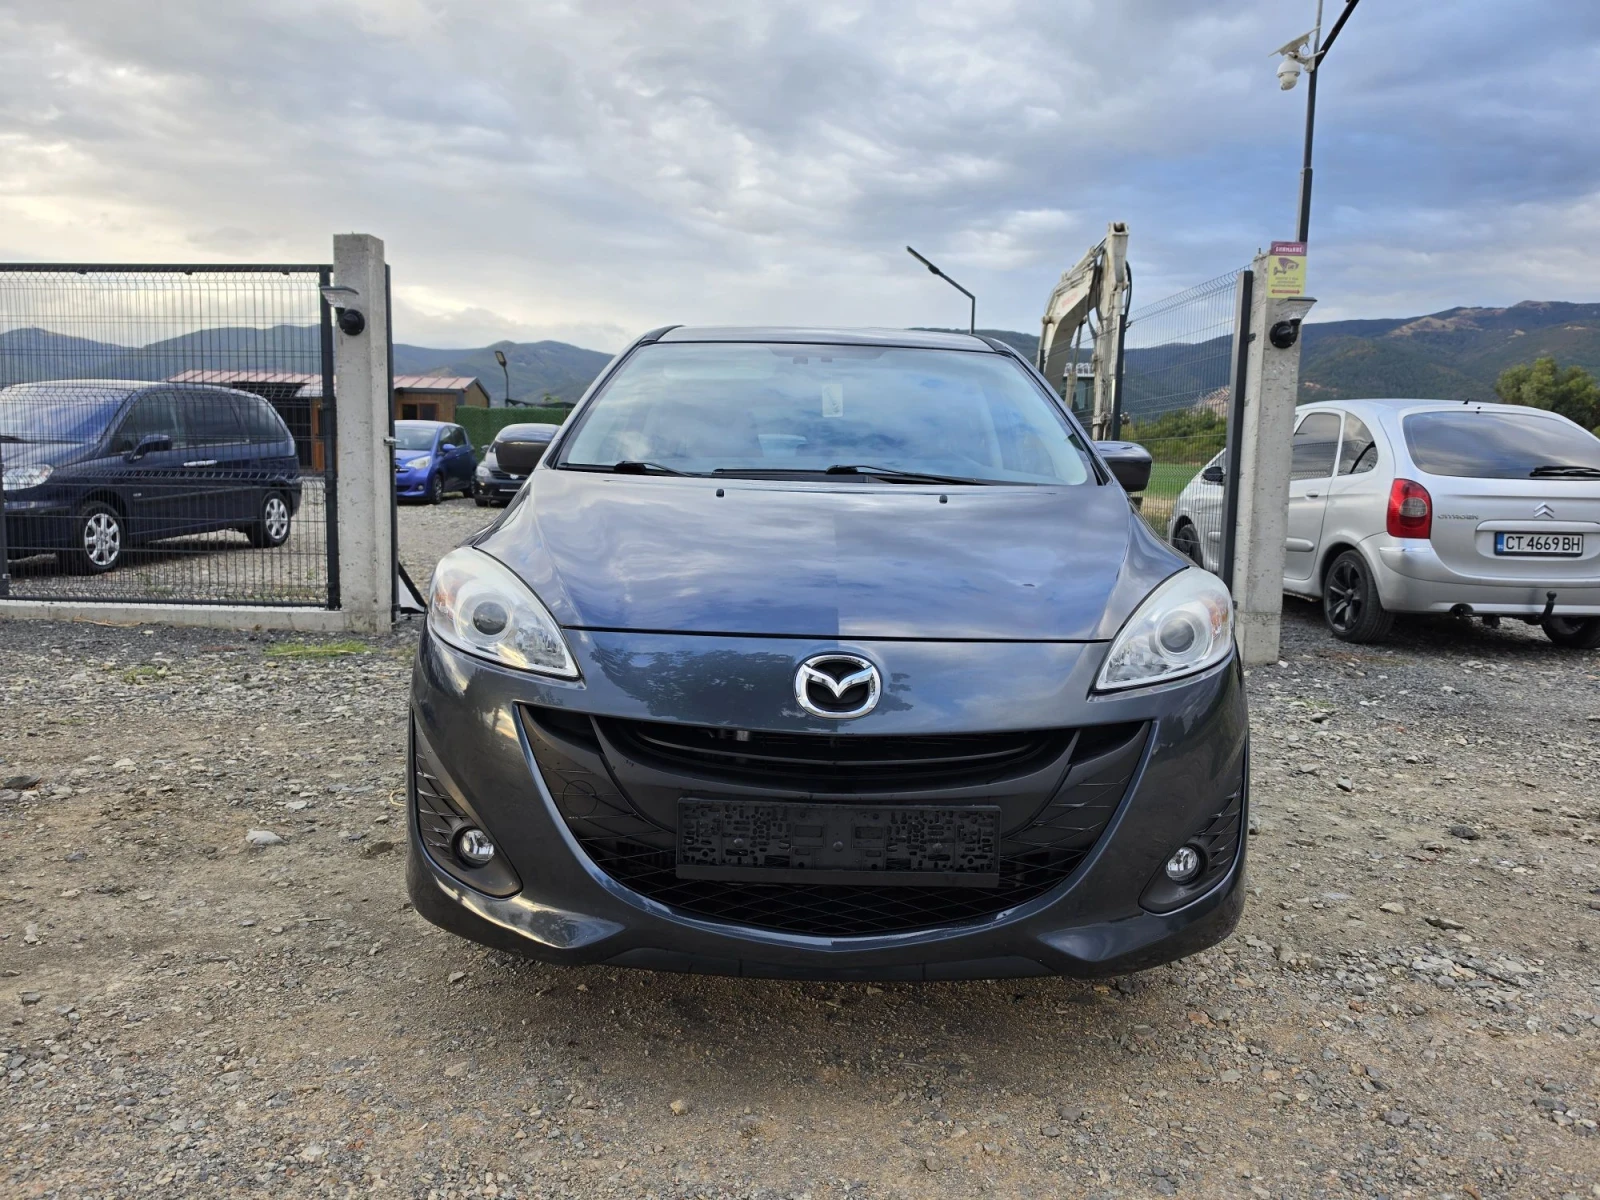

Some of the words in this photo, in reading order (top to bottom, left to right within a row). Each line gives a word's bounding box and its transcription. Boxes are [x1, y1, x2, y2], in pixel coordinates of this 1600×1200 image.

[1506, 536, 1524, 550] CT
[1526, 536, 1560, 551] 4669
[1562, 537, 1580, 551] BH
